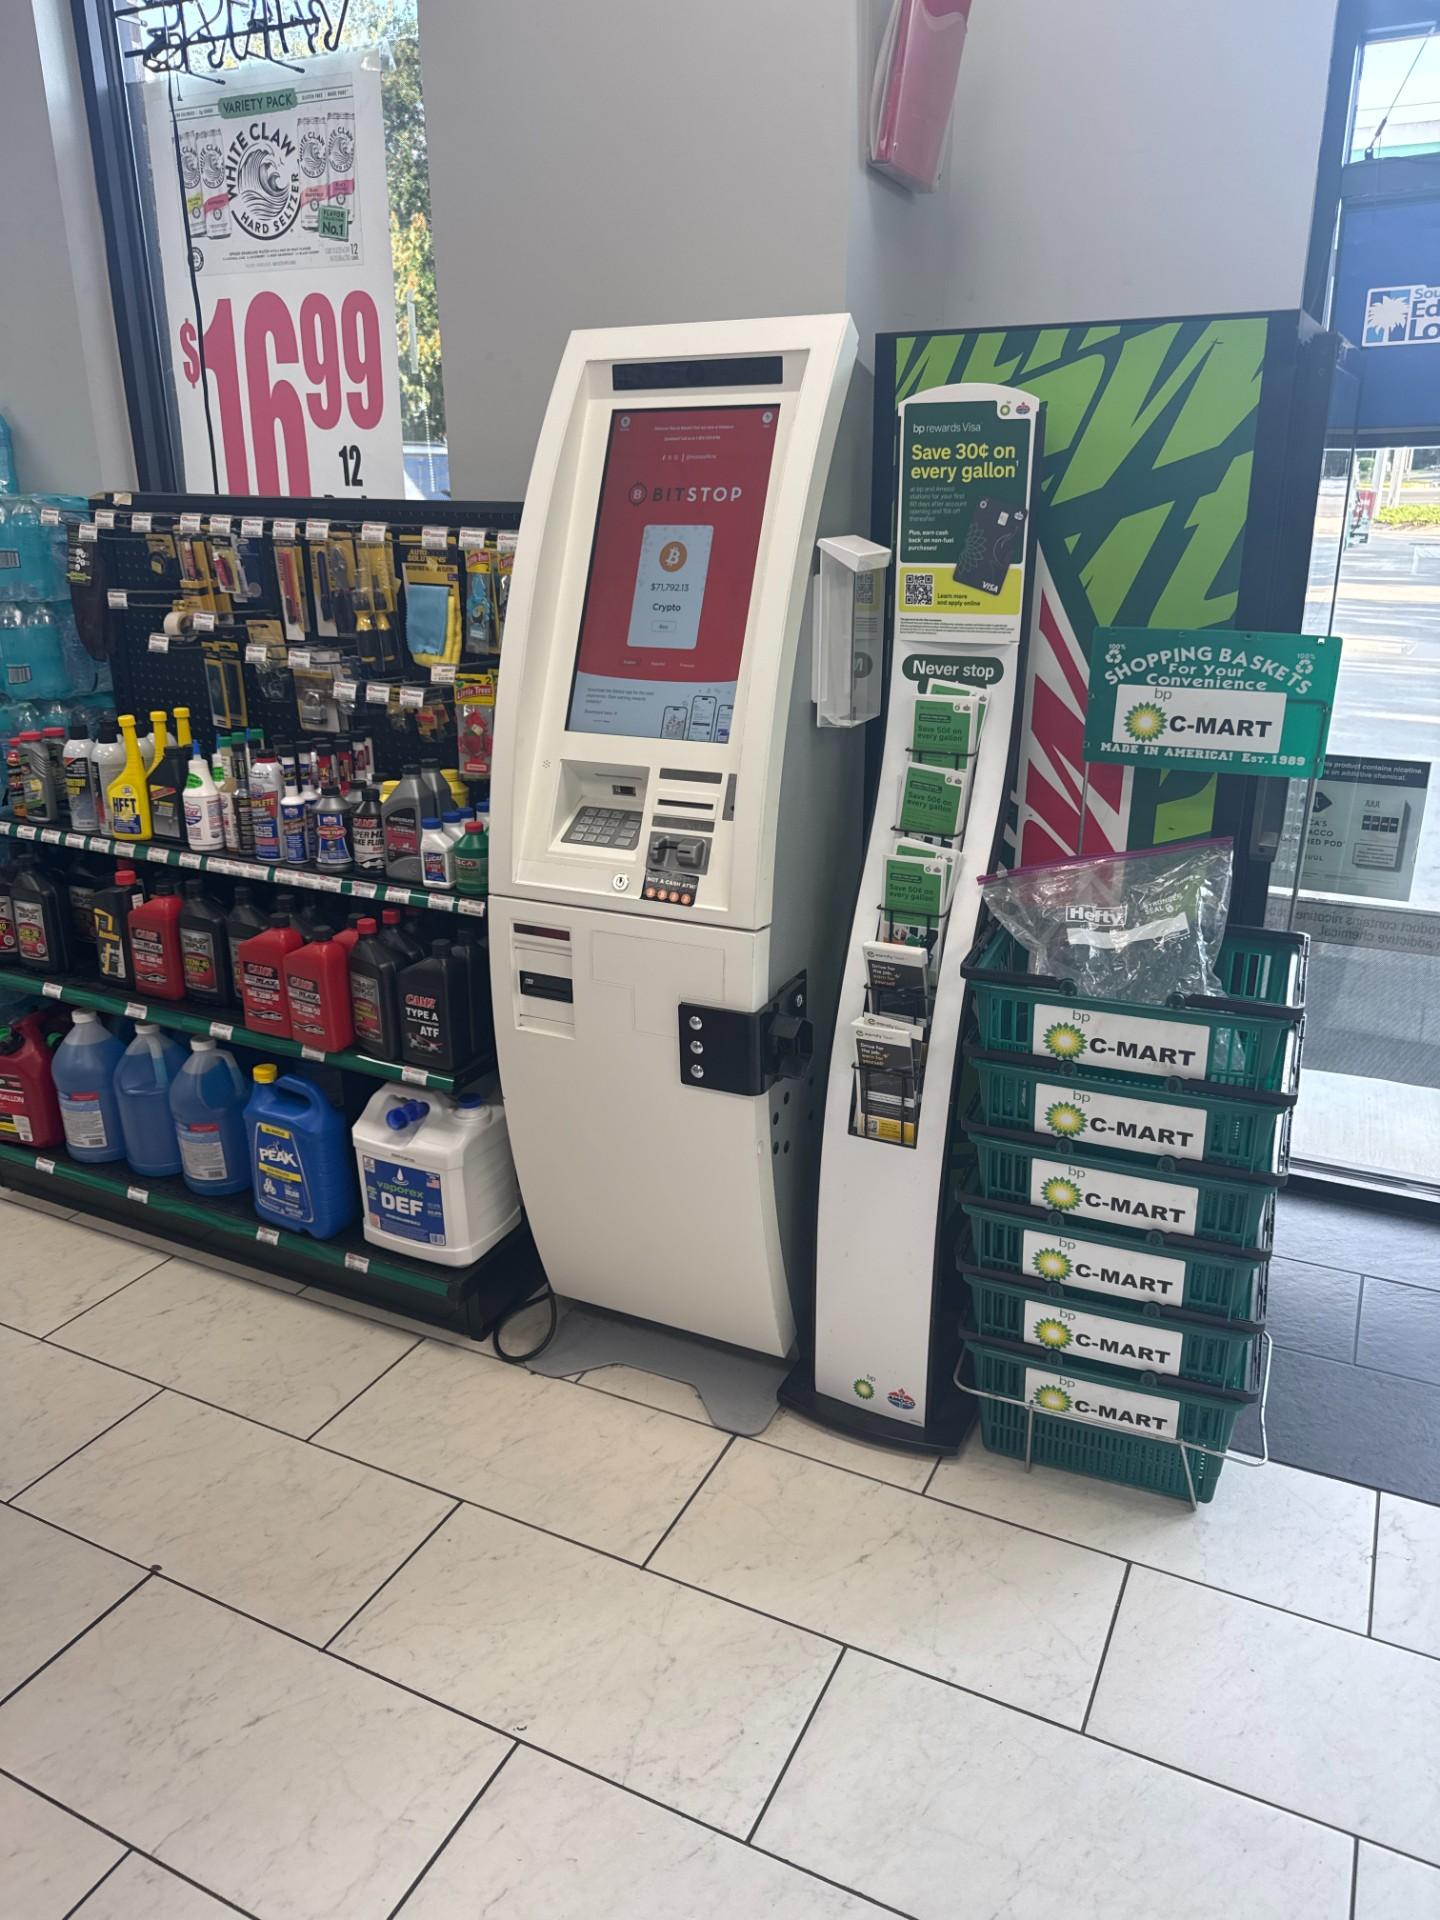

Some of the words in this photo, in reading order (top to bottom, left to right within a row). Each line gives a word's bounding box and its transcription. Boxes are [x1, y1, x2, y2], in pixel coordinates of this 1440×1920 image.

[223, 98, 263, 113] VARIETY
[266, 94, 293, 107] PACK
[225, 131, 248, 201] WHITE
[249, 122, 296, 157] CLAW
[240, 212, 269, 234] HARD
[274, 174, 299, 231] SELTZER
[323, 210, 345, 218] FLAVOR
[350, 244, 358, 255] 12
[913, 424, 925, 435] bp
[926, 424, 961, 433] rewards
[962, 422, 981, 432] Visa
[912, 444, 951, 460] Save
[955, 443, 989, 459] 30¢
[994, 446, 1015, 459] on
[339, 445, 363, 487] 12
[911, 466, 957, 483] every
[652, 487, 742, 502] BITSTOP
[982, 581, 998, 592] VISA
[652, 603, 681, 613] Crypto
[912, 660, 958, 676] Never
[963, 664, 995, 680] stop
[1105, 646, 1213, 685] SHOPPING
[1219, 649, 1312, 694] BASKETS
[1168, 663, 1197, 675] For
[1204, 664, 1244, 677] Your
[1146, 673, 1267, 691] Convenience
[474, 686, 492, 696] Trees
[1155, 688, 1172, 702] bp
[1170, 716, 1272, 738] C-MART
[1100, 742, 1138, 755] MADE
[1144, 746, 1158, 756] IN
[1165, 747, 1233, 761] AMERICA!
[1271, 755, 1306, 766] 1989
[1334, 762, 1361, 770] product
[1362, 764, 1392, 772] contains
[1324, 840, 1343, 848] POD
[1070, 907, 1122, 925] Hefty
[405, 1007, 429, 1020] TYPE
[432, 1013, 438, 1021] A
[1072, 1009, 1090, 1023] bp
[420, 1026, 439, 1038] ATF
[1089, 1037, 1196, 1066] C-MART
[1072, 1090, 1091, 1104] bp
[1090, 1117, 1194, 1147] C-MART
[259, 1148, 298, 1167] PEAK
[1068, 1166, 1086, 1179] bp
[377, 1180, 424, 1199] vaporex
[381, 1191, 423, 1216] DEF
[1085, 1193, 1186, 1224] C-MART
[1059, 1237, 1076, 1250] bp
[1075, 1263, 1173, 1294] C-MART
[1059, 1309, 1076, 1321] bp
[1075, 1333, 1171, 1364] C-MART
[1059, 1375, 1076, 1388] bp
[1075, 1400, 1168, 1430] C-MART
